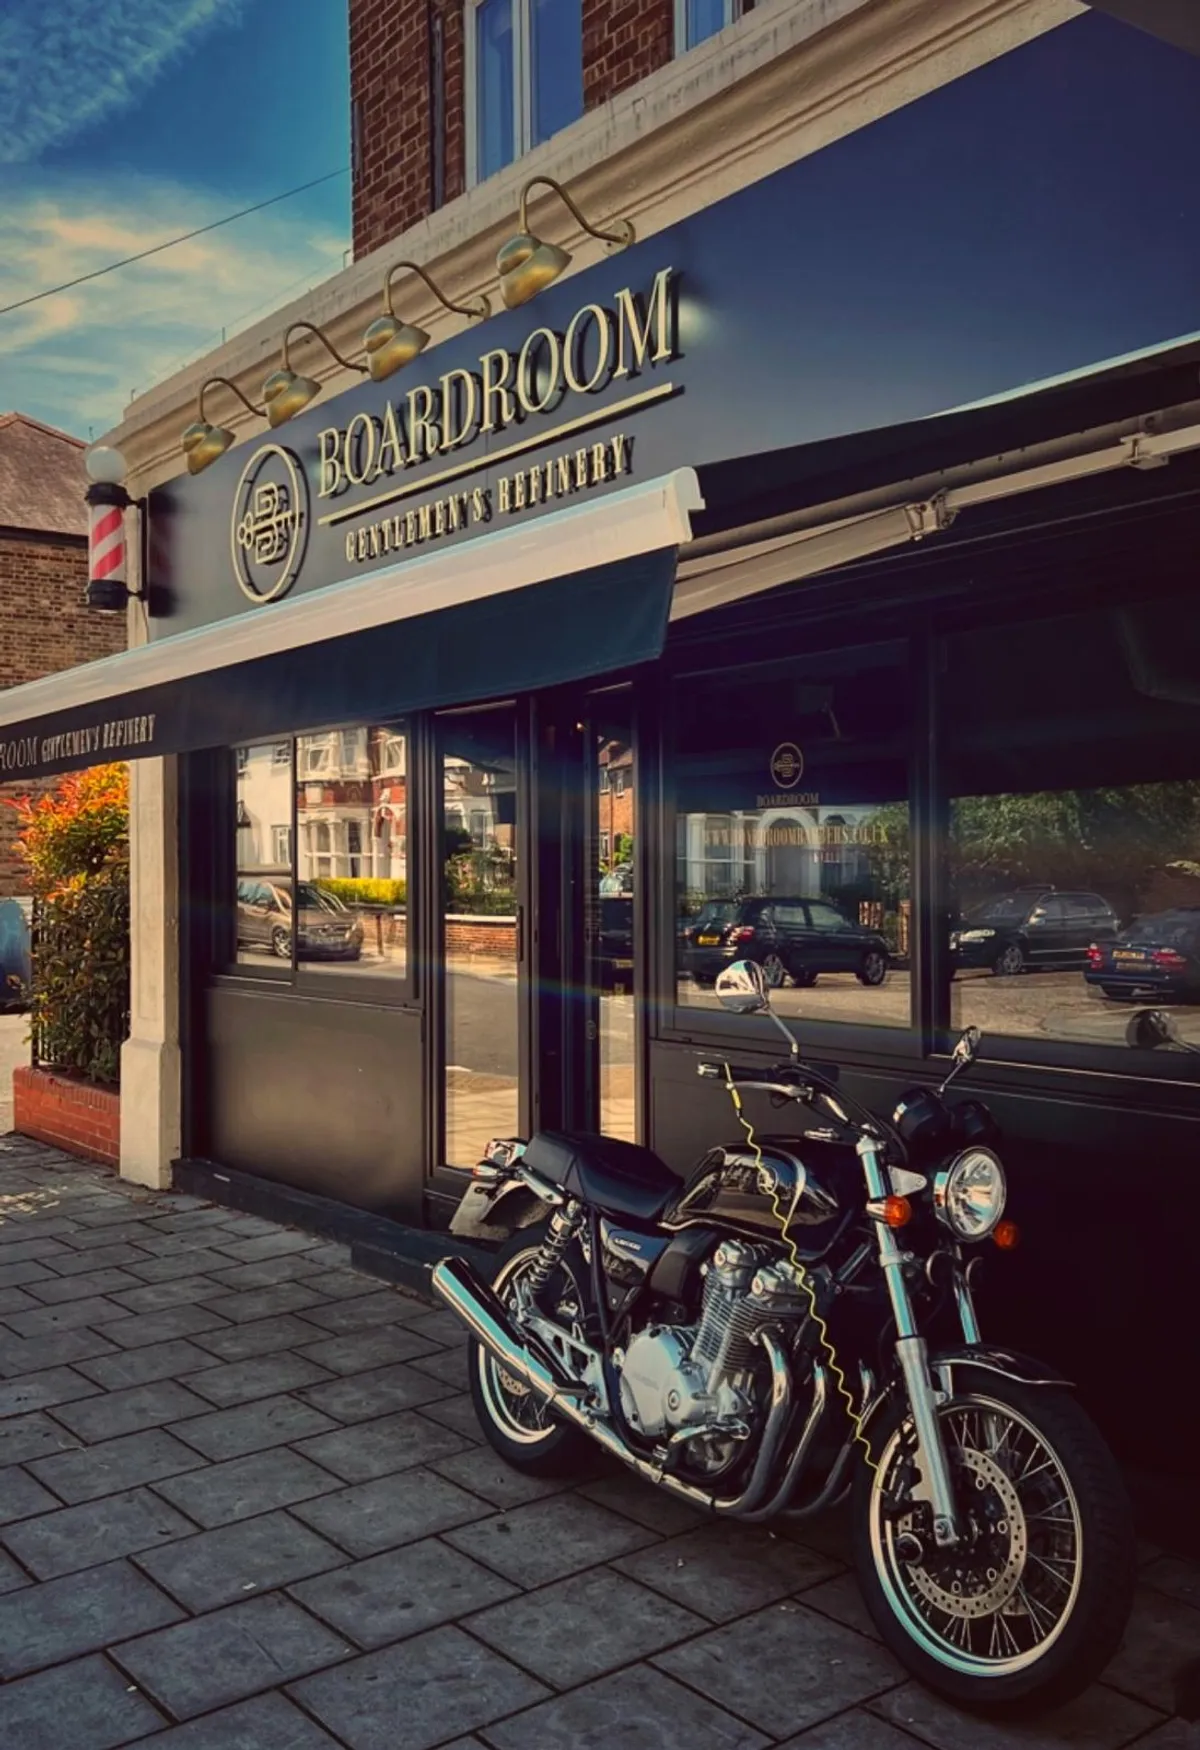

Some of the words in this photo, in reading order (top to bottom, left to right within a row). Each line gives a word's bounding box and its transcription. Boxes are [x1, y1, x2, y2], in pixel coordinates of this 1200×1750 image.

[317, 266, 672, 497] BOARDROOM
[345, 487, 482, 562] GENTLEMEN'S
[498, 434, 625, 513] REFINERY
[103, 714, 156, 749] REFINERY
